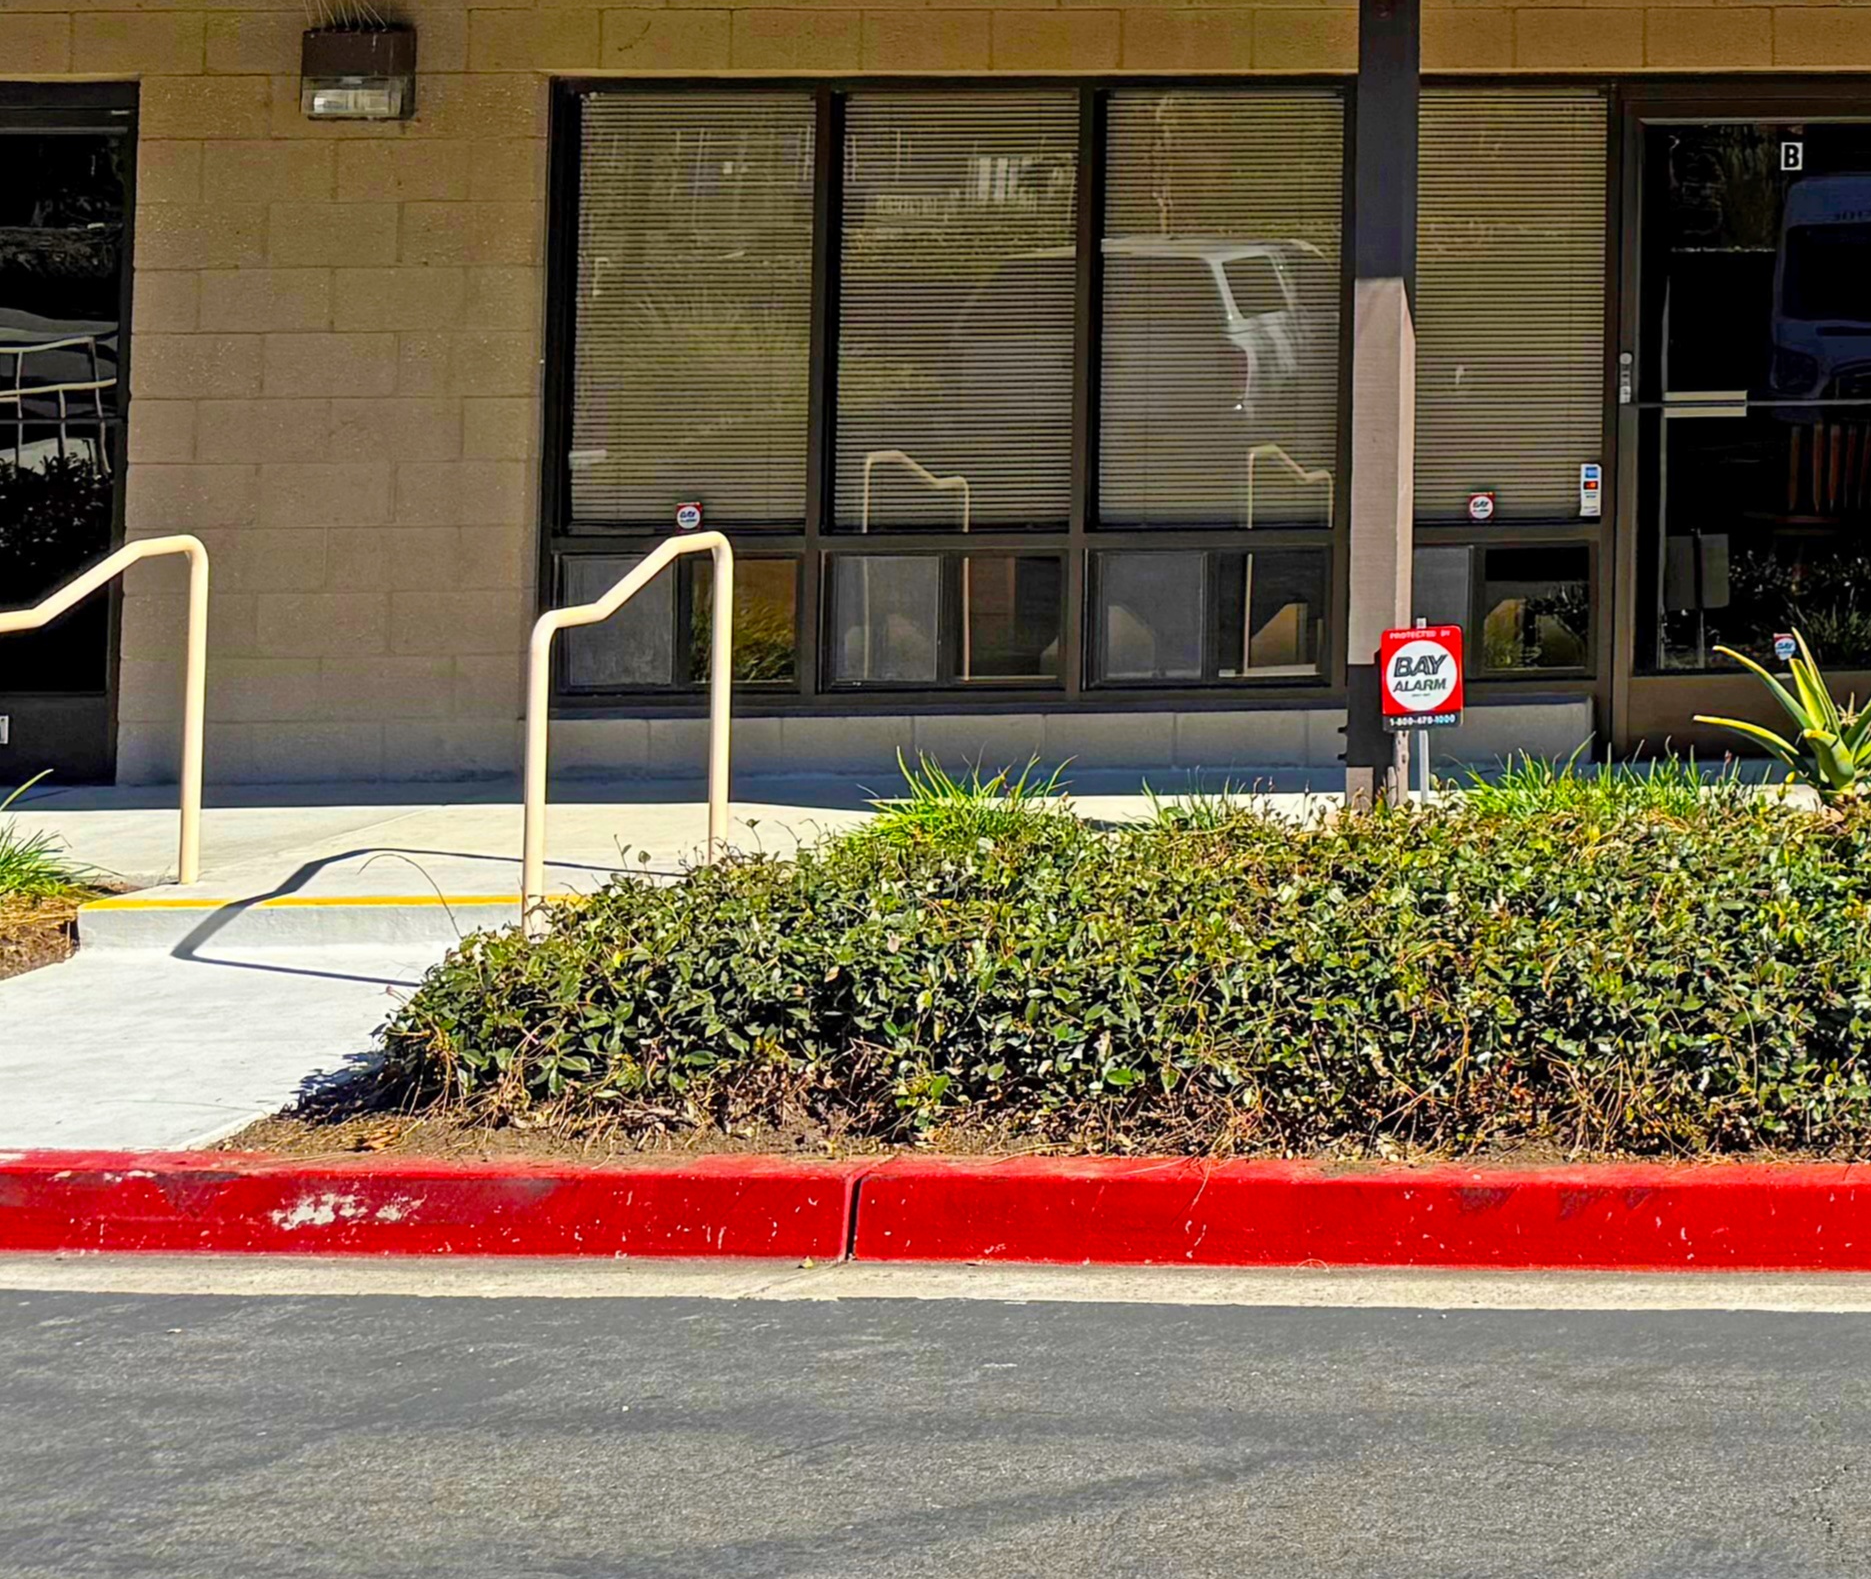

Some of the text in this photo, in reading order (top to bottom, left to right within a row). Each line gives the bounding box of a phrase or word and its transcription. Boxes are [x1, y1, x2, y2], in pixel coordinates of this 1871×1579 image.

[1784, 144, 1800, 168] B
[1394, 655, 1448, 677] BAY
[1393, 678, 1446, 692] ALARM
